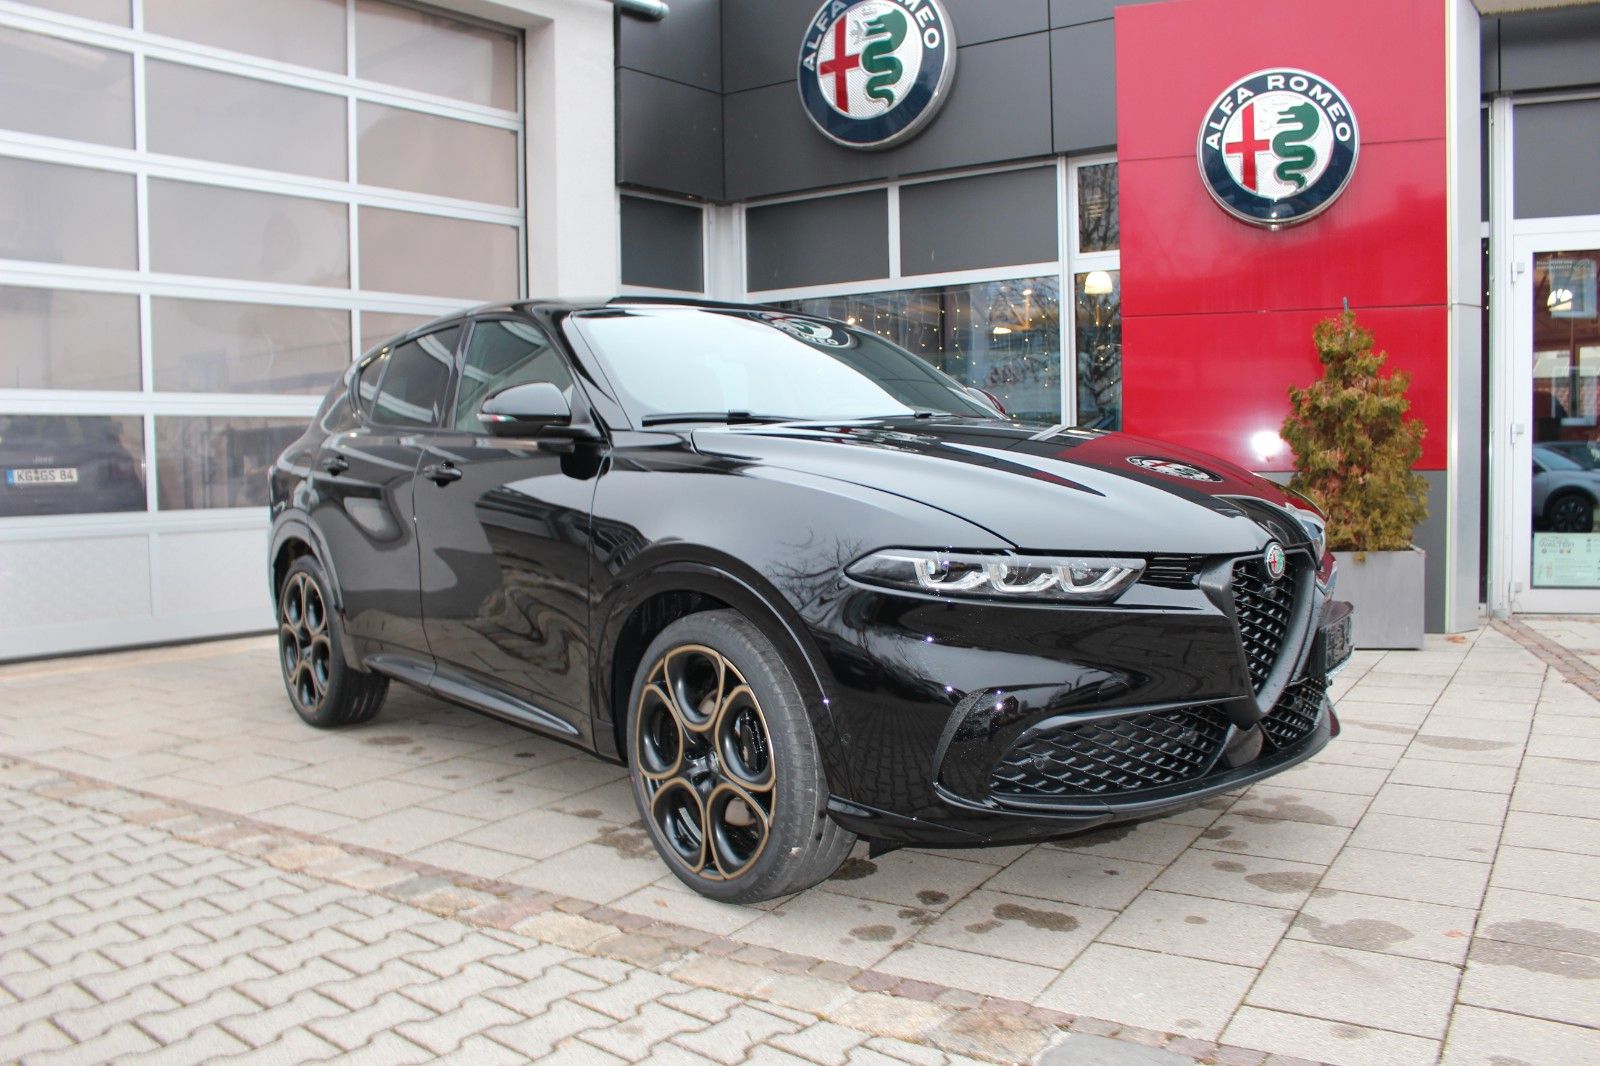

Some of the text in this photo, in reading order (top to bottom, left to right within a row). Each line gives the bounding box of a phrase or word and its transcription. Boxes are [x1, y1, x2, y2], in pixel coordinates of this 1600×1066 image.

[803, 0, 848, 71] ALFA
[1205, 74, 1352, 151] ALFA ROMEO
[16, 470, 33, 482] KG
[40, 470, 56, 481] GS
